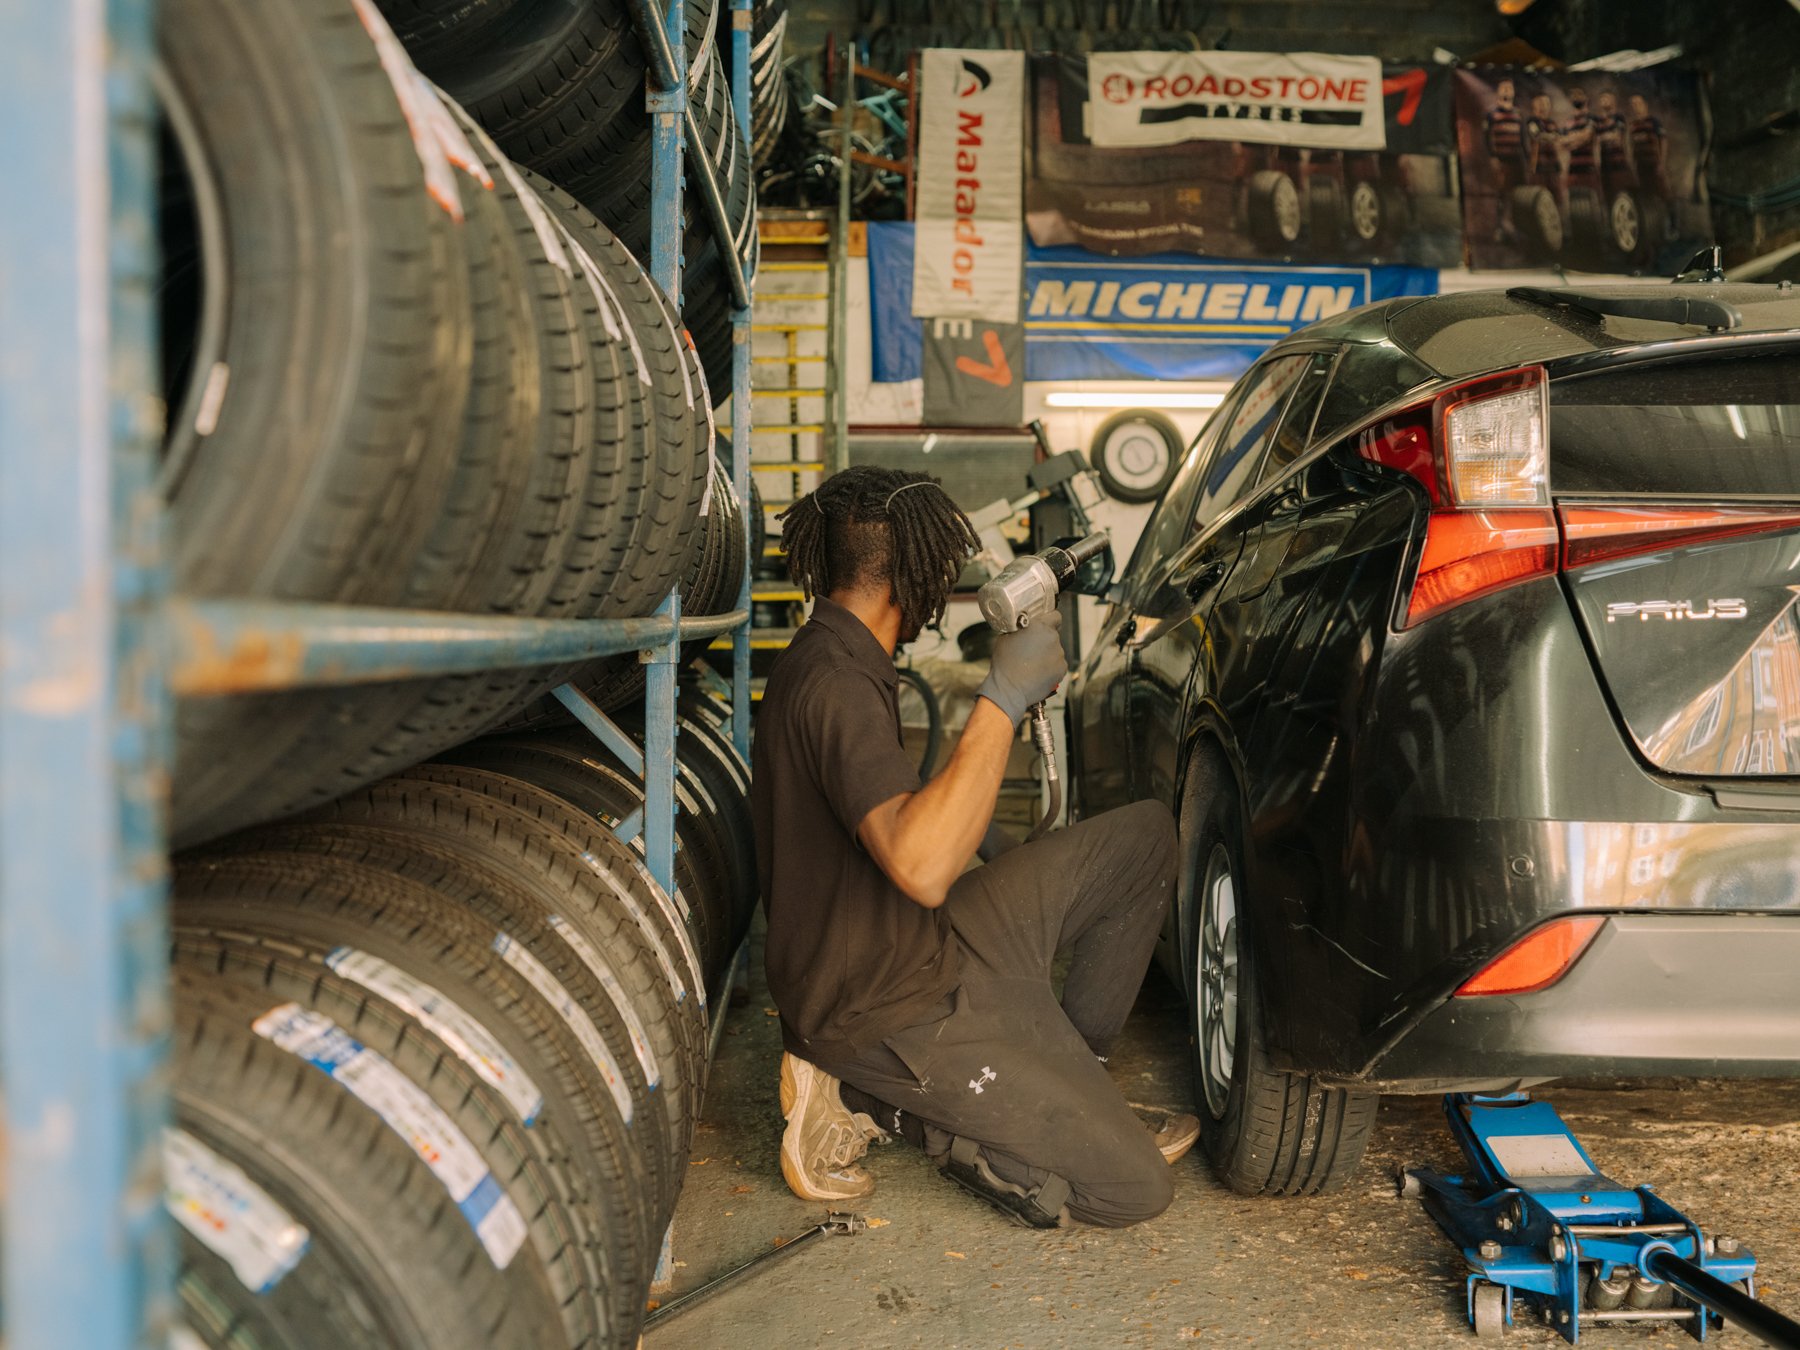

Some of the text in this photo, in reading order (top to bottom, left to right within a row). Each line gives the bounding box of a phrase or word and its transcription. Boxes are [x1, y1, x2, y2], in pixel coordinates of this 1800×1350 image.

[1143, 74, 1370, 103] ROADSTONE
[1204, 102, 1304, 123] TYRES
[951, 110, 984, 297] Matador
[1028, 280, 1354, 321] MICHELIN
[1607, 598, 1748, 623] PRIUS
